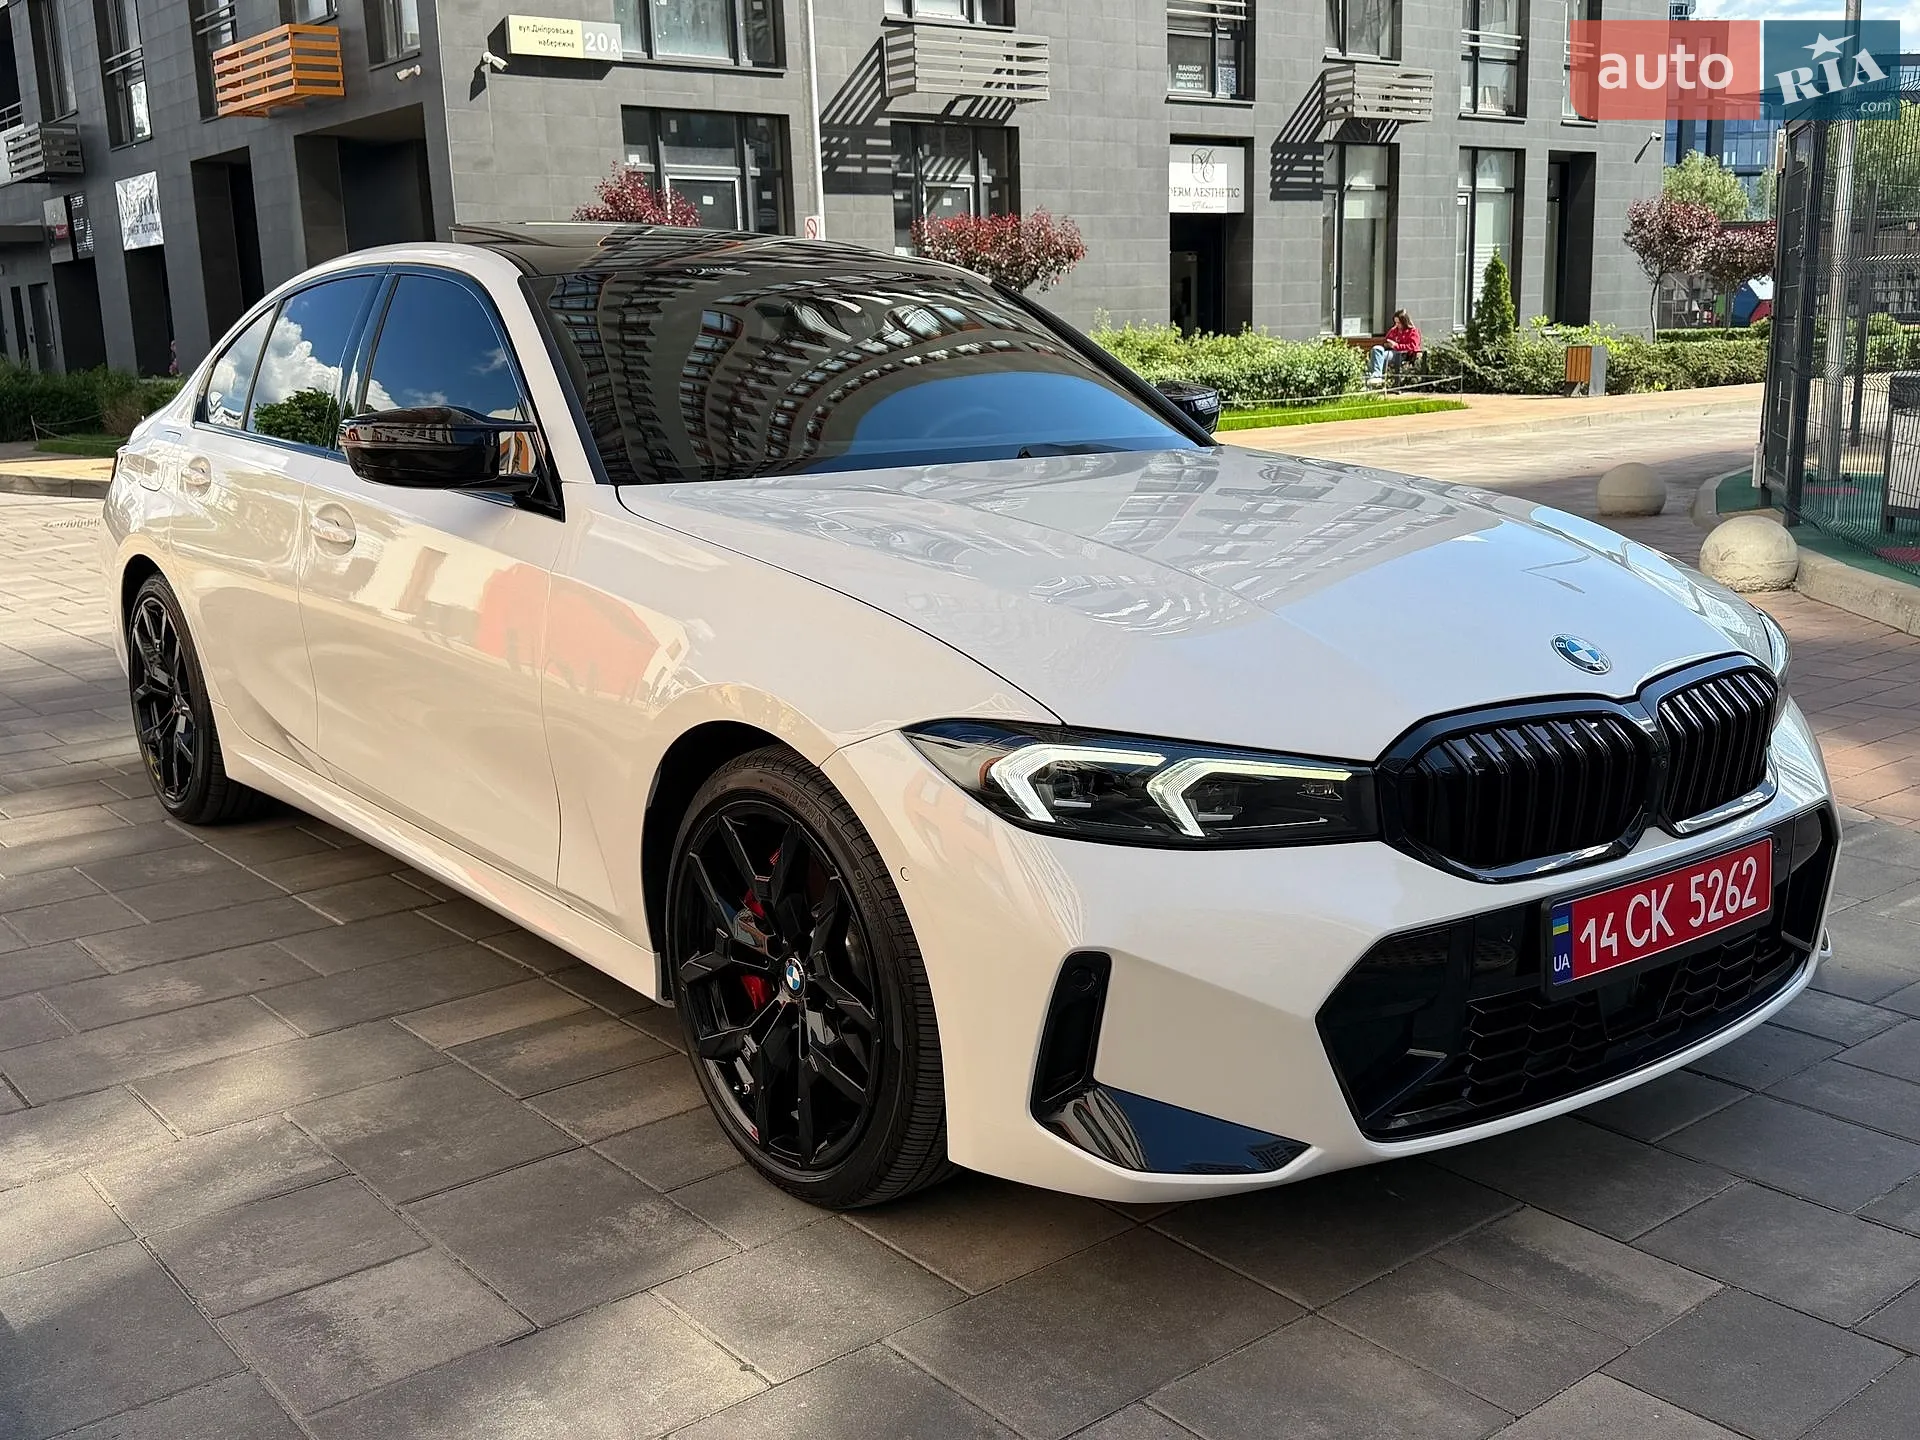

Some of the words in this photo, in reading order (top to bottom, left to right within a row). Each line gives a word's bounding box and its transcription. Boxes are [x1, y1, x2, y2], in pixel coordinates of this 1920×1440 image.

[1193, 187, 1240, 198] AESTHETIC
[1688, 856, 1757, 928] 5262
[1553, 953, 1571, 972] UA
